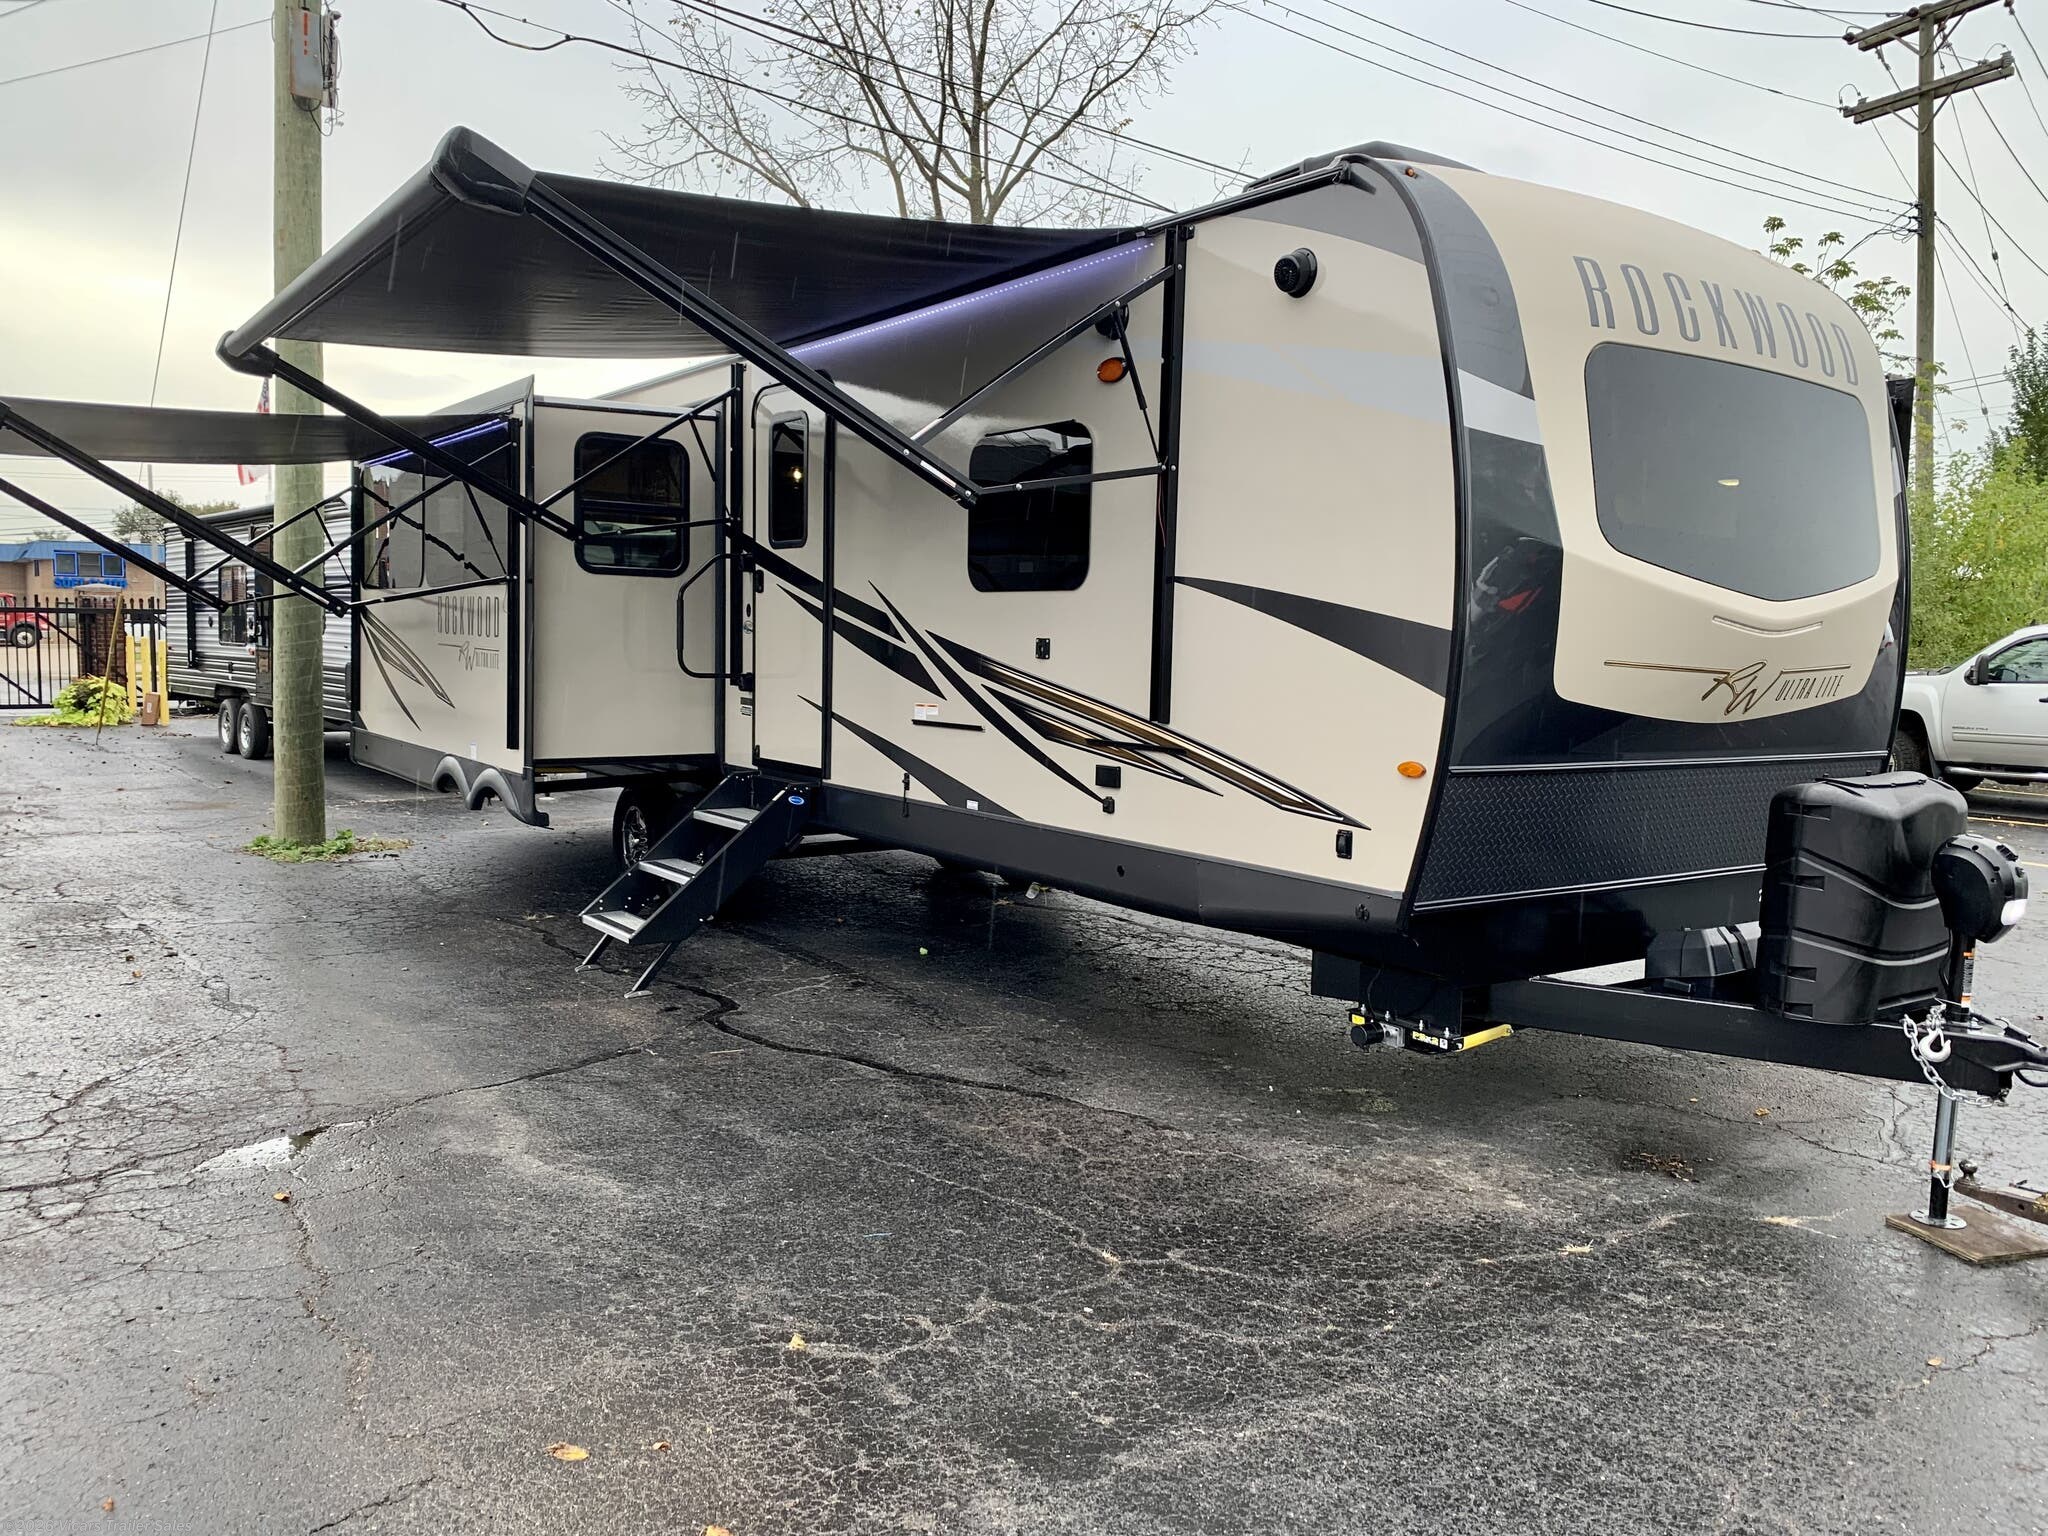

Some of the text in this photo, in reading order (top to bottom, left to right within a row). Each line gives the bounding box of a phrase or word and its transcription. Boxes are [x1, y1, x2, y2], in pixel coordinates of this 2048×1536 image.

[1573, 255, 1858, 386] ROCKWOOD
[437, 596, 500, 638] ROCKWOOD
[1775, 678, 1817, 702] ULTRA
[1815, 675, 1844, 698] LITE
